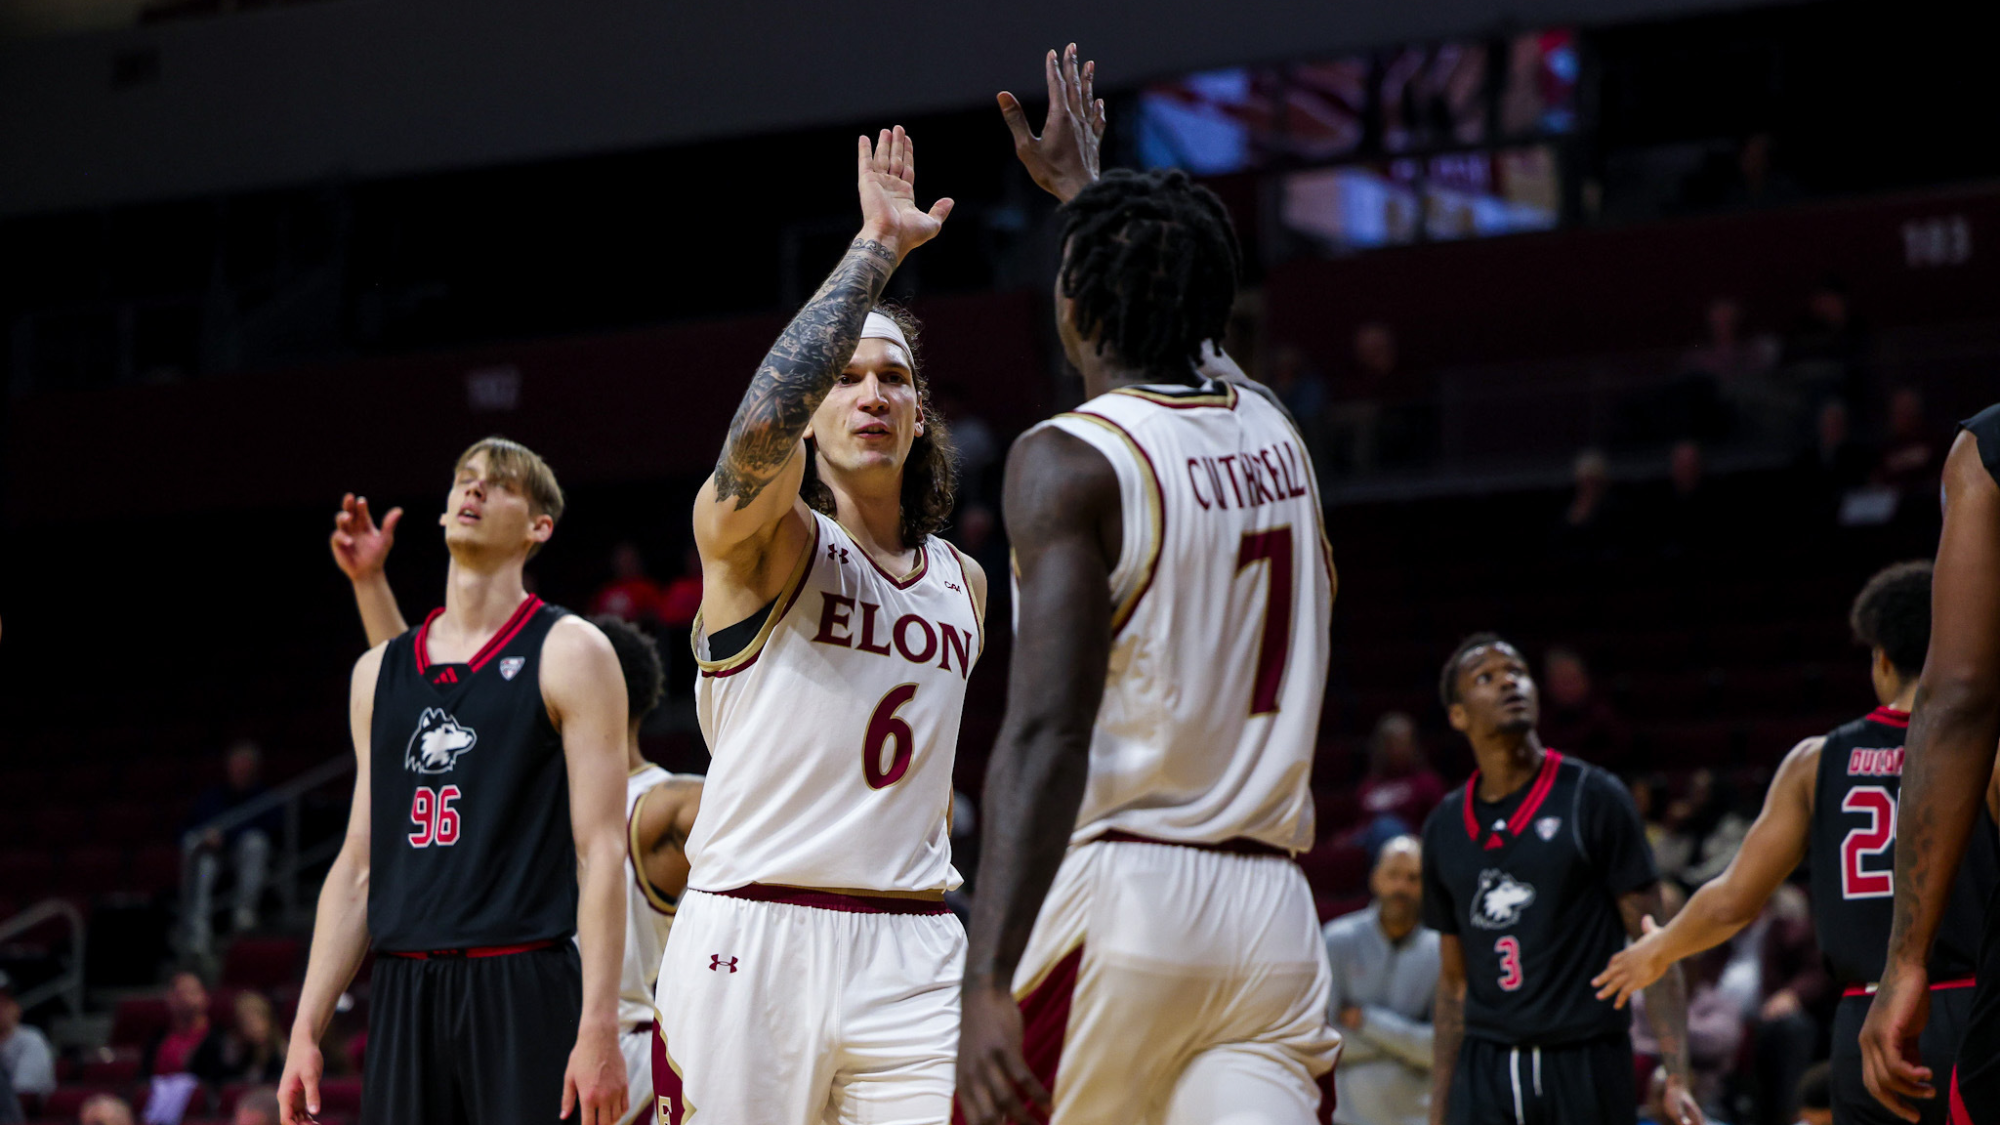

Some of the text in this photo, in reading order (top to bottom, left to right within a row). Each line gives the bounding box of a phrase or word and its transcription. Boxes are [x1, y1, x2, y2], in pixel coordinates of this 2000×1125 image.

[1186, 441, 1306, 511] CUTHRELL
[811, 591, 973, 681] ELON
[1235, 522, 1294, 719] 7
[861, 682, 920, 791] 6
[408, 784, 461, 848] 96
[1841, 785, 1901, 900] 2
[1494, 935, 1523, 991] 3
